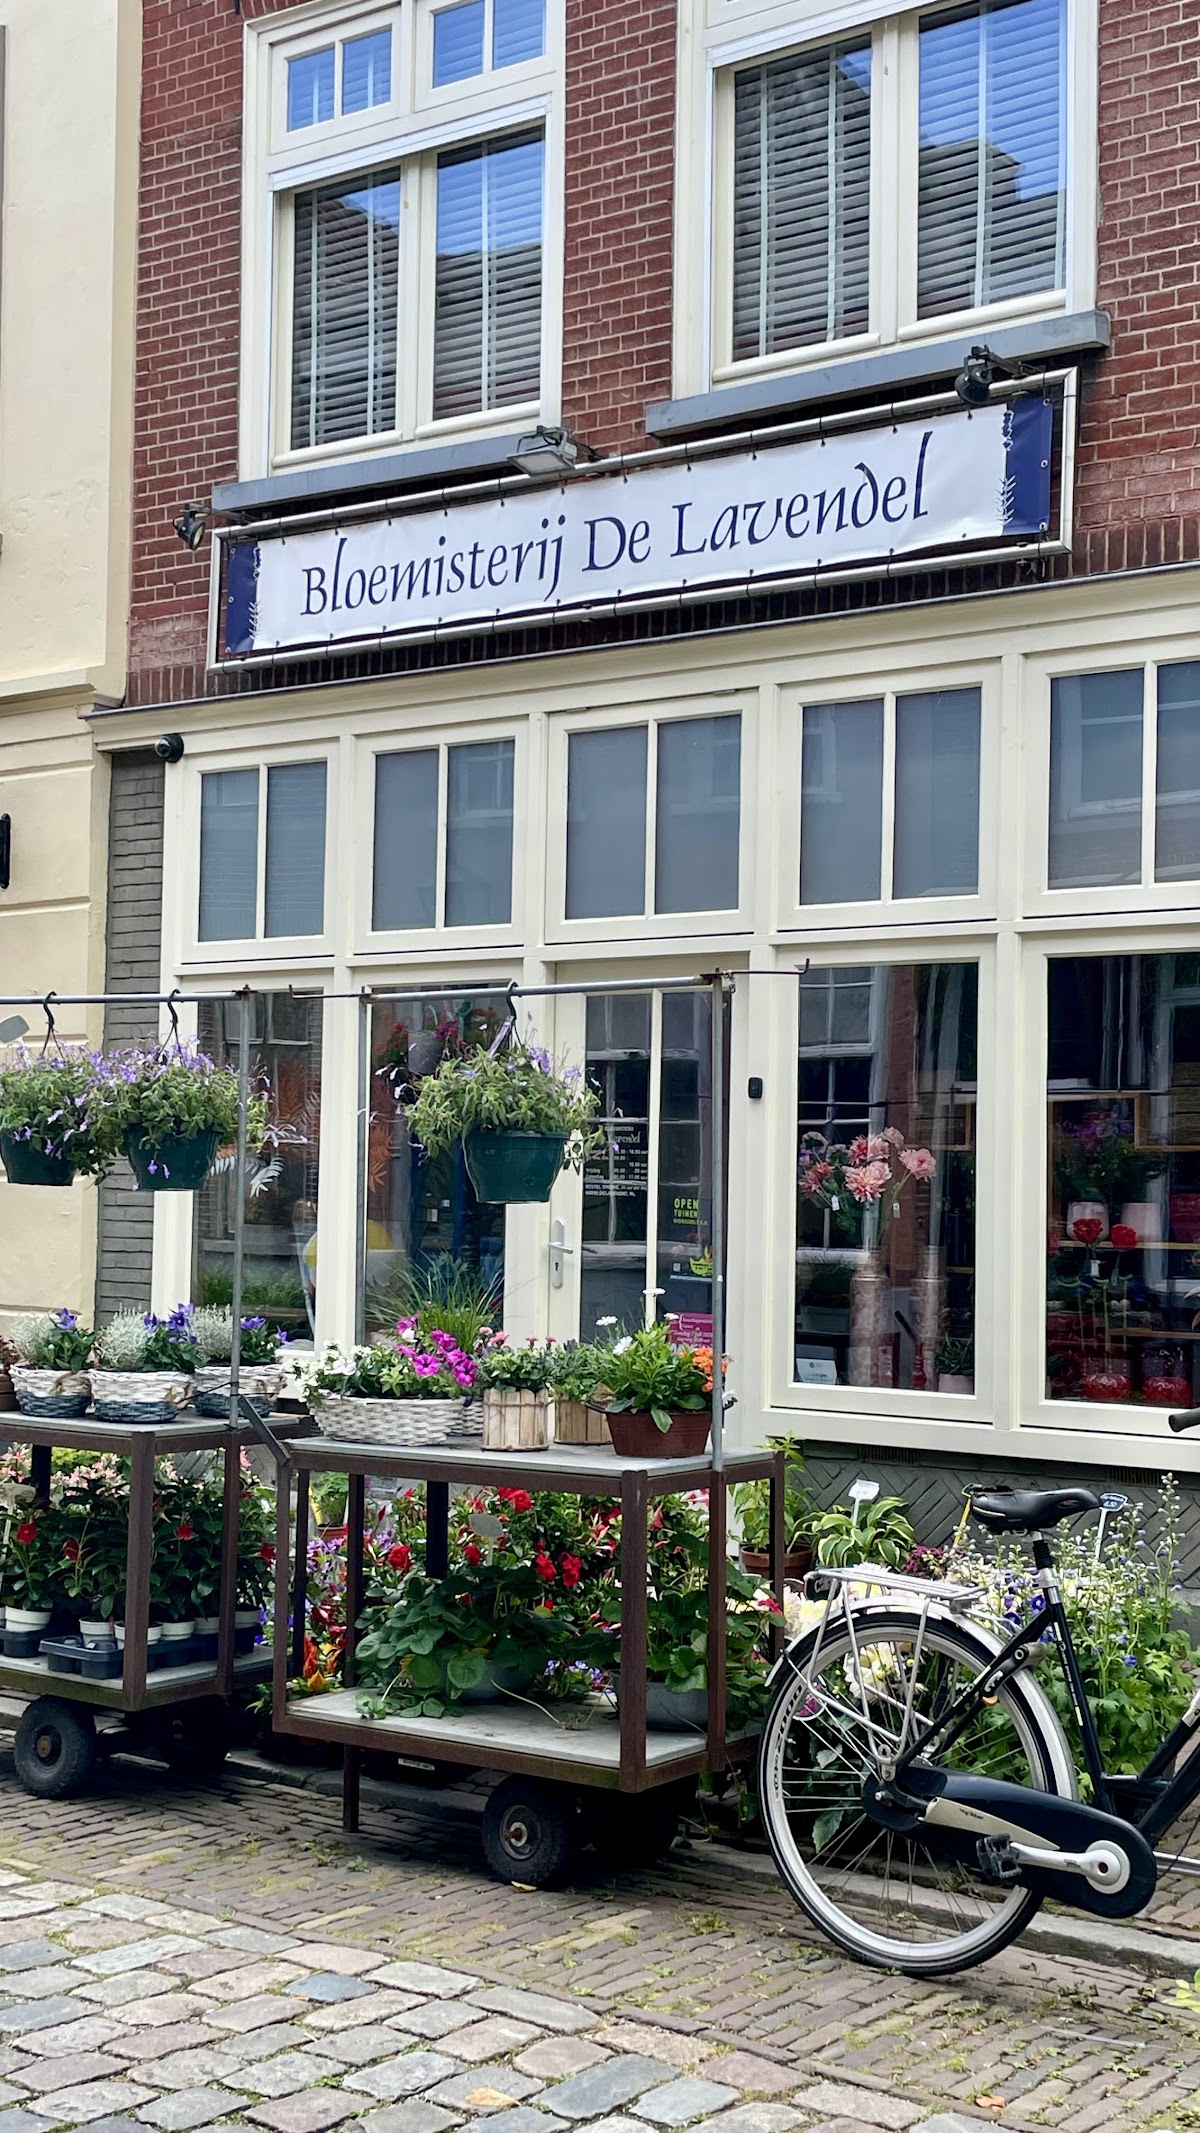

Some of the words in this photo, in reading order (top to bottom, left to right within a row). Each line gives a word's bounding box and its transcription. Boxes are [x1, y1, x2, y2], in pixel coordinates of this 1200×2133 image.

[302, 515, 566, 616] Bloemisterij
[581, 517, 653, 572] De
[669, 431, 933, 560] Lavendel
[674, 1198, 699, 1209] OPEN
